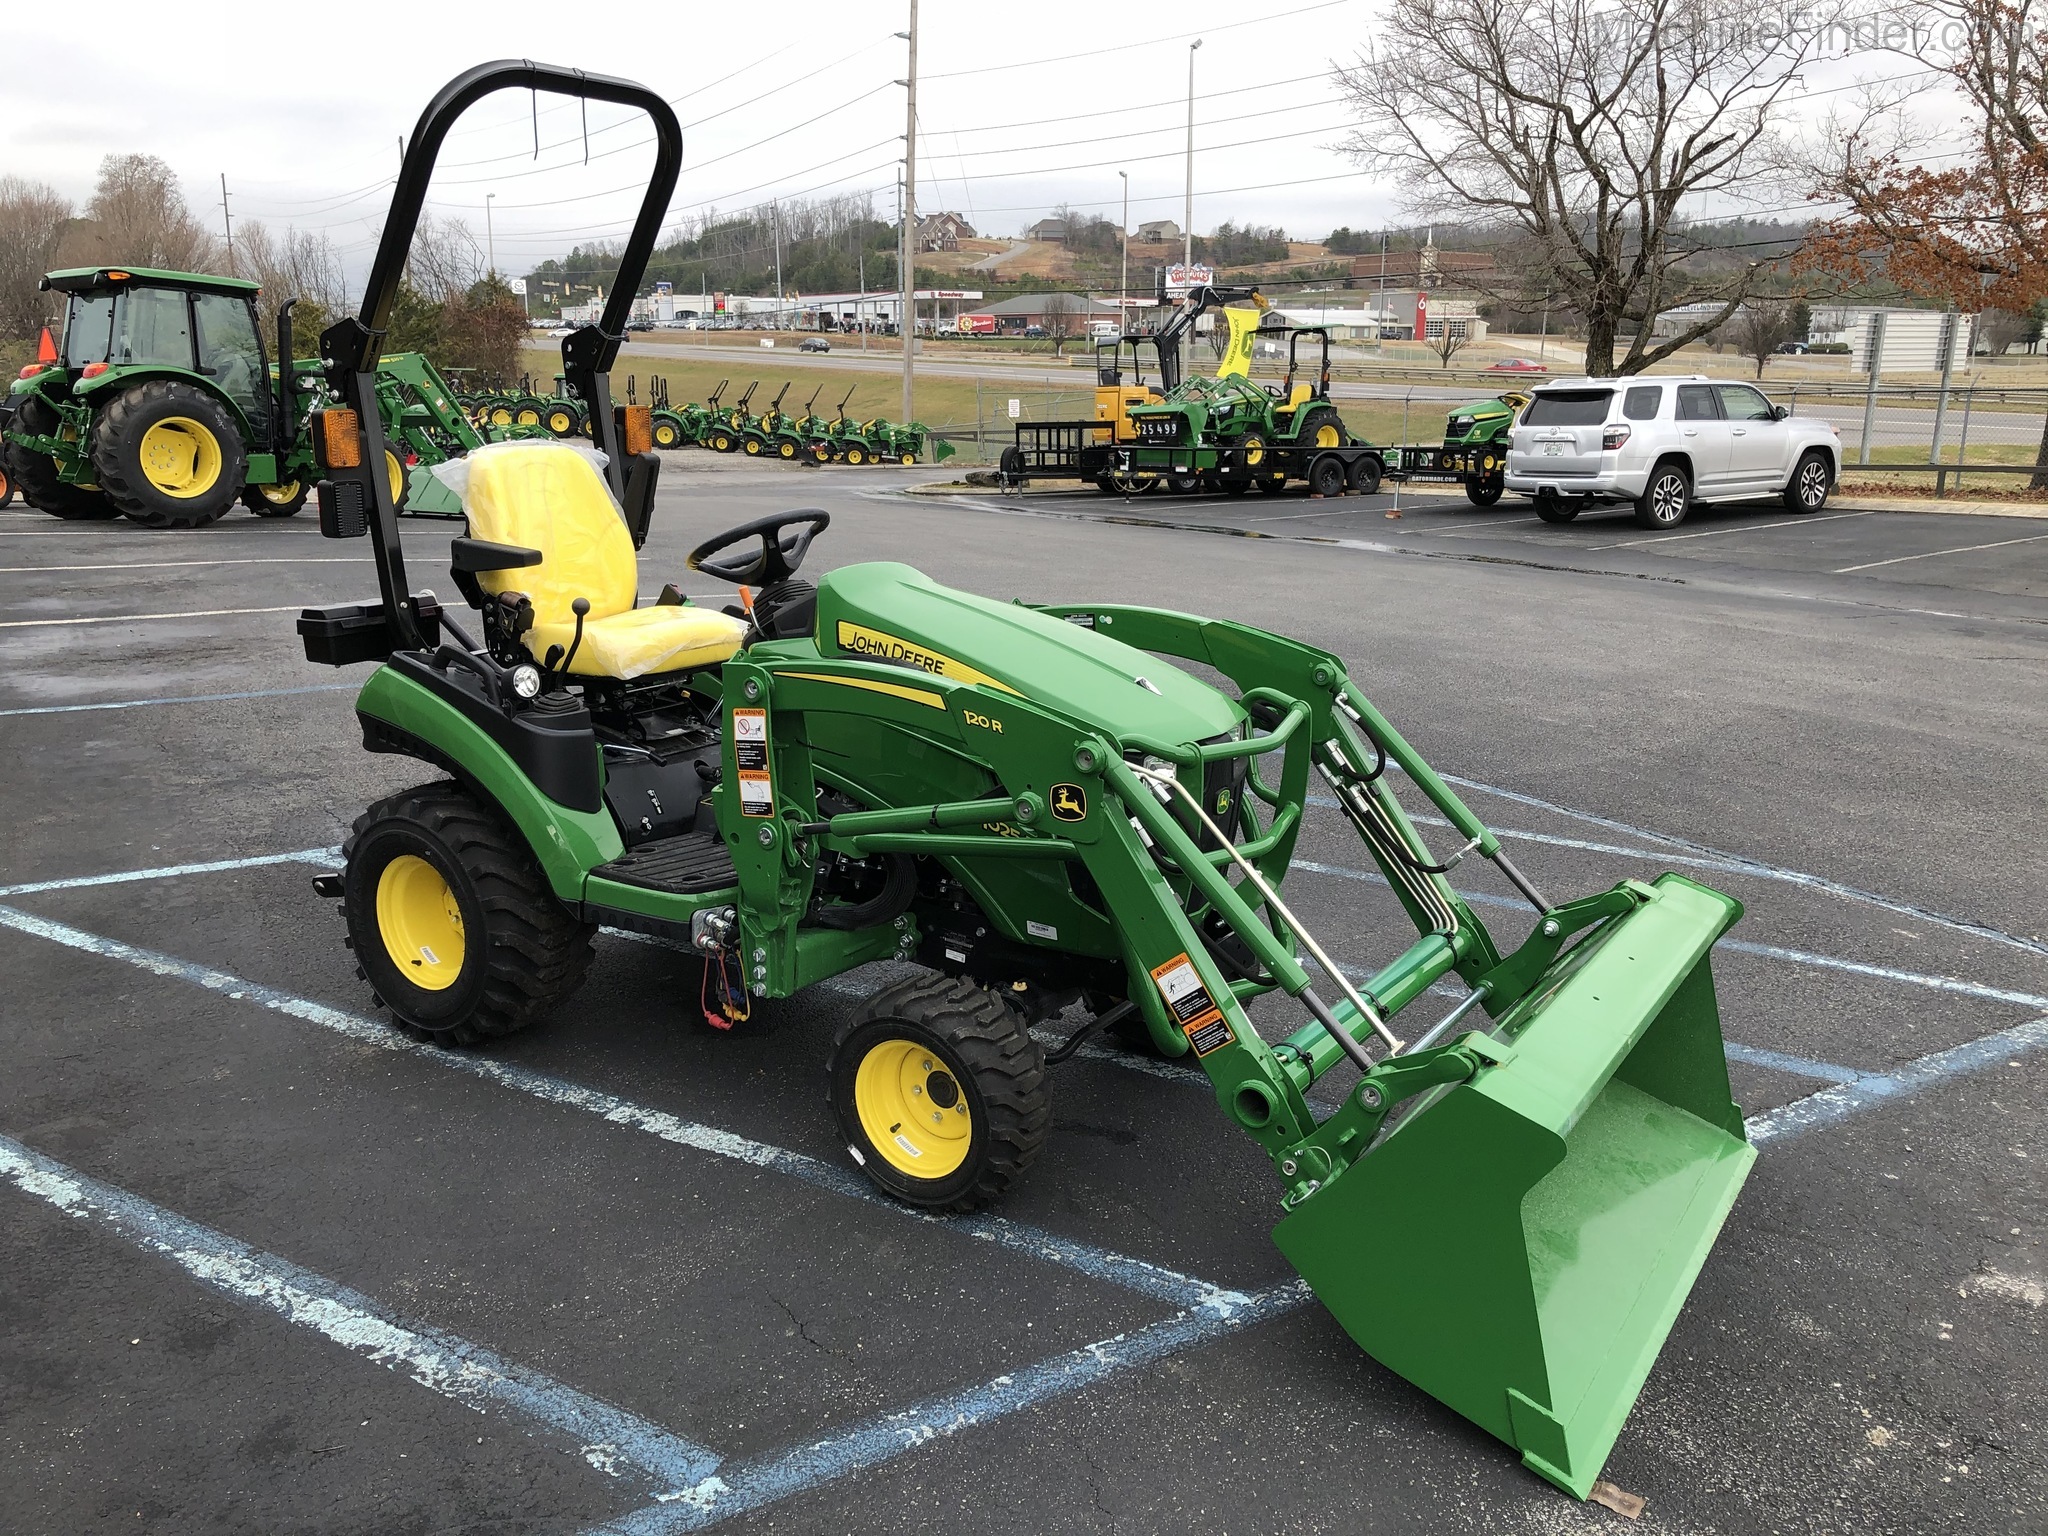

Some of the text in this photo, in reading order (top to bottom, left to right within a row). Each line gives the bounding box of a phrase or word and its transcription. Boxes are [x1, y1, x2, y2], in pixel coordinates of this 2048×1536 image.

[937, 291, 965, 299] Speedway
[1166, 291, 1187, 300] AHEA
[1418, 297, 1426, 310] 6
[847, 632, 946, 675] JOHN DEERE
[1161, 957, 1185, 974] WARNING
[1194, 1013, 1218, 1030] WARNING
